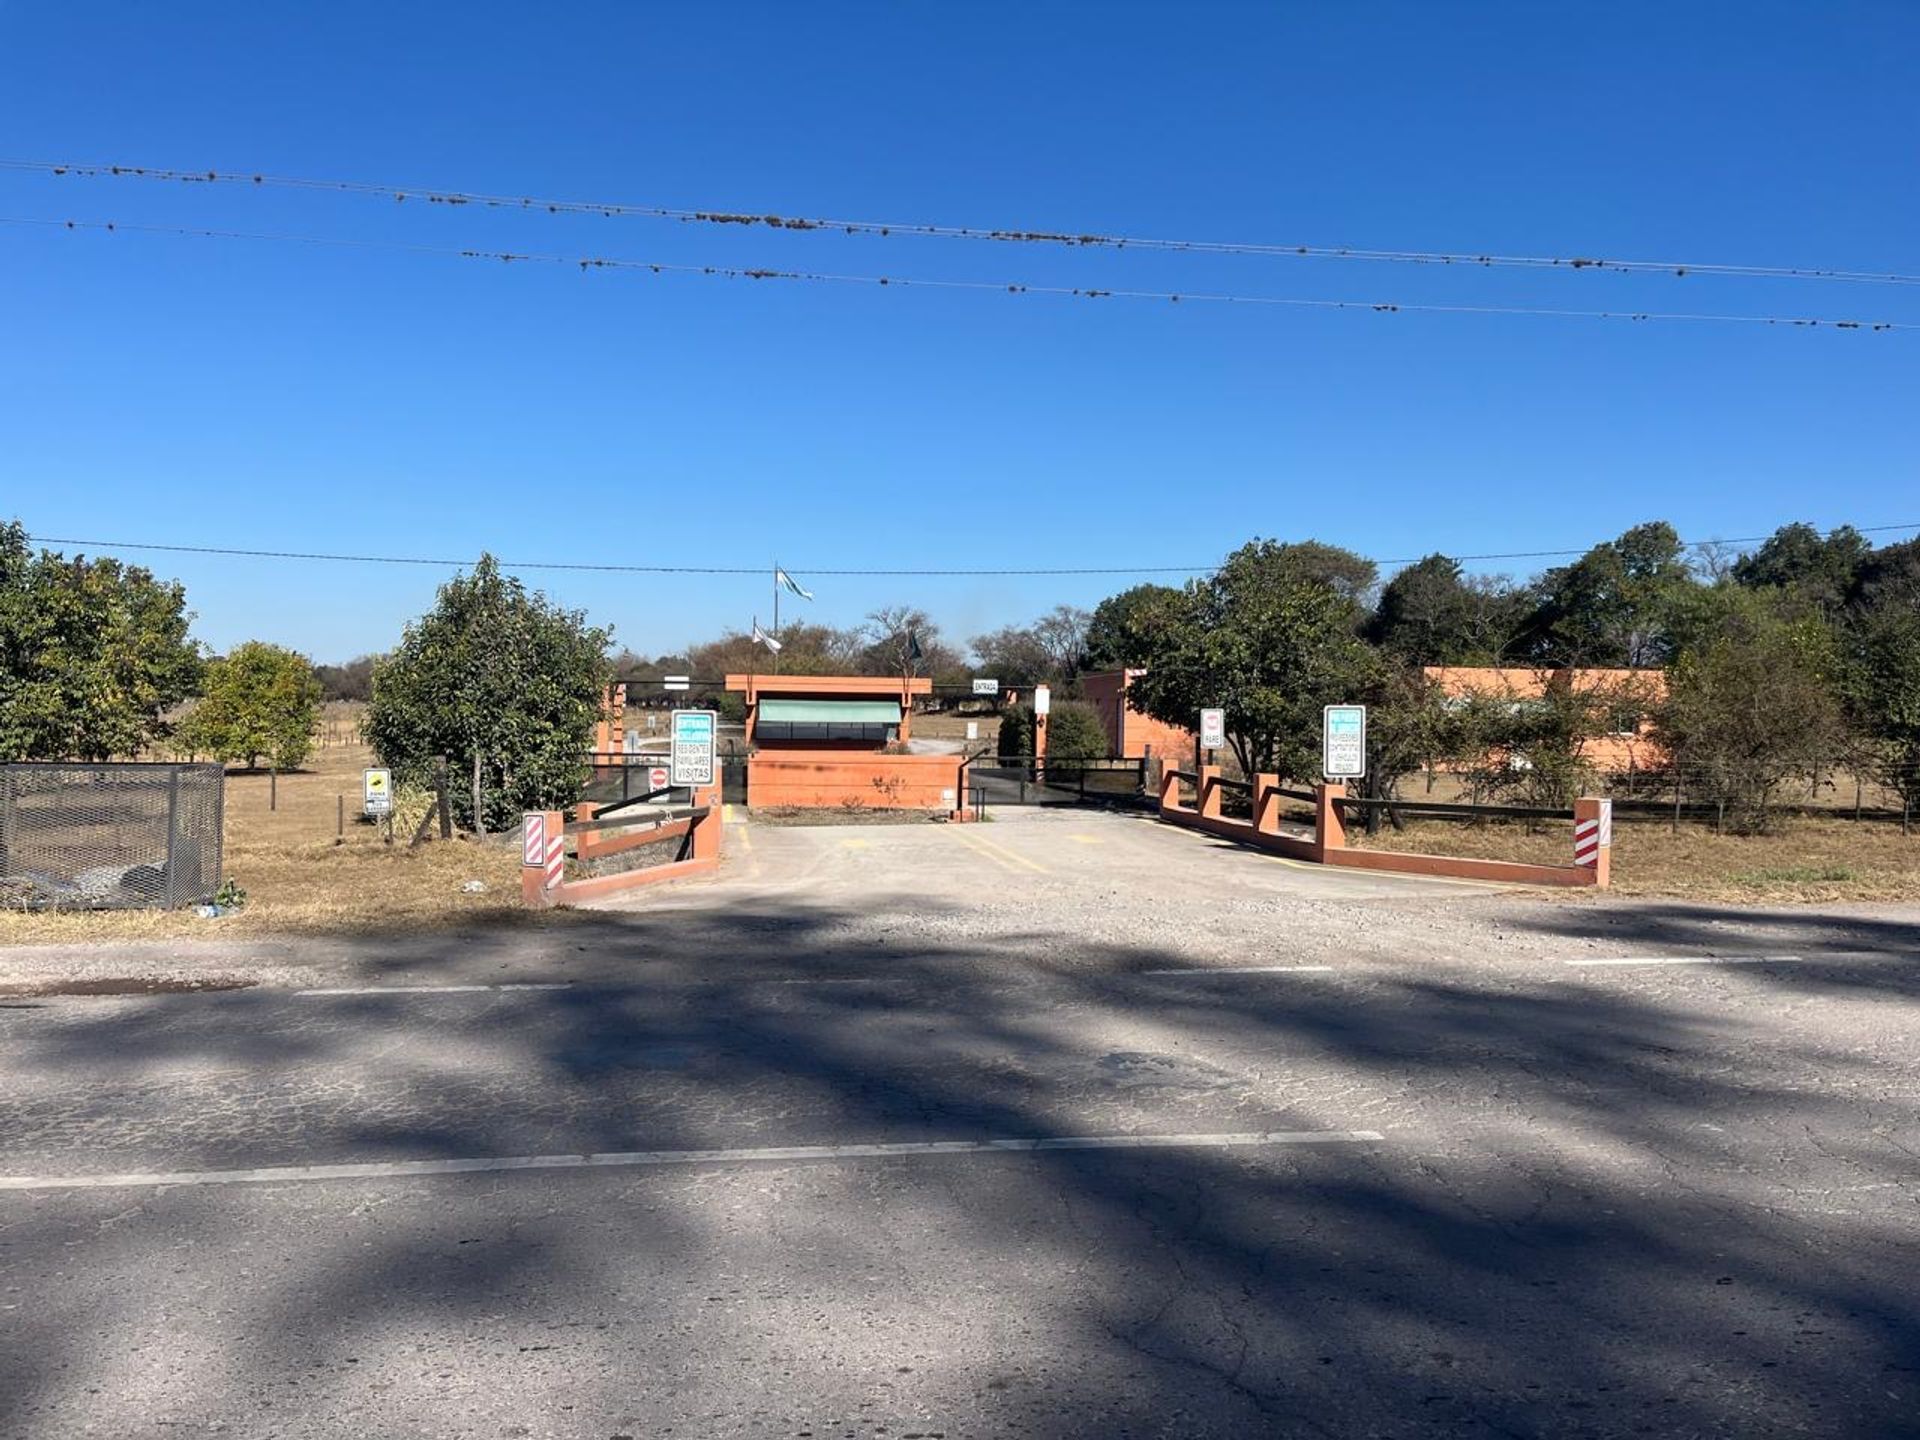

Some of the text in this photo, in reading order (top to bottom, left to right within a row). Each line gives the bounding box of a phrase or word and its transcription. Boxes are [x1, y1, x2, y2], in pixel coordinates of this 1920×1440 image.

[678, 744, 710, 755] RESIDENTES
[677, 756, 710, 766] FAMILIARES
[678, 768, 710, 780] VISITAS
